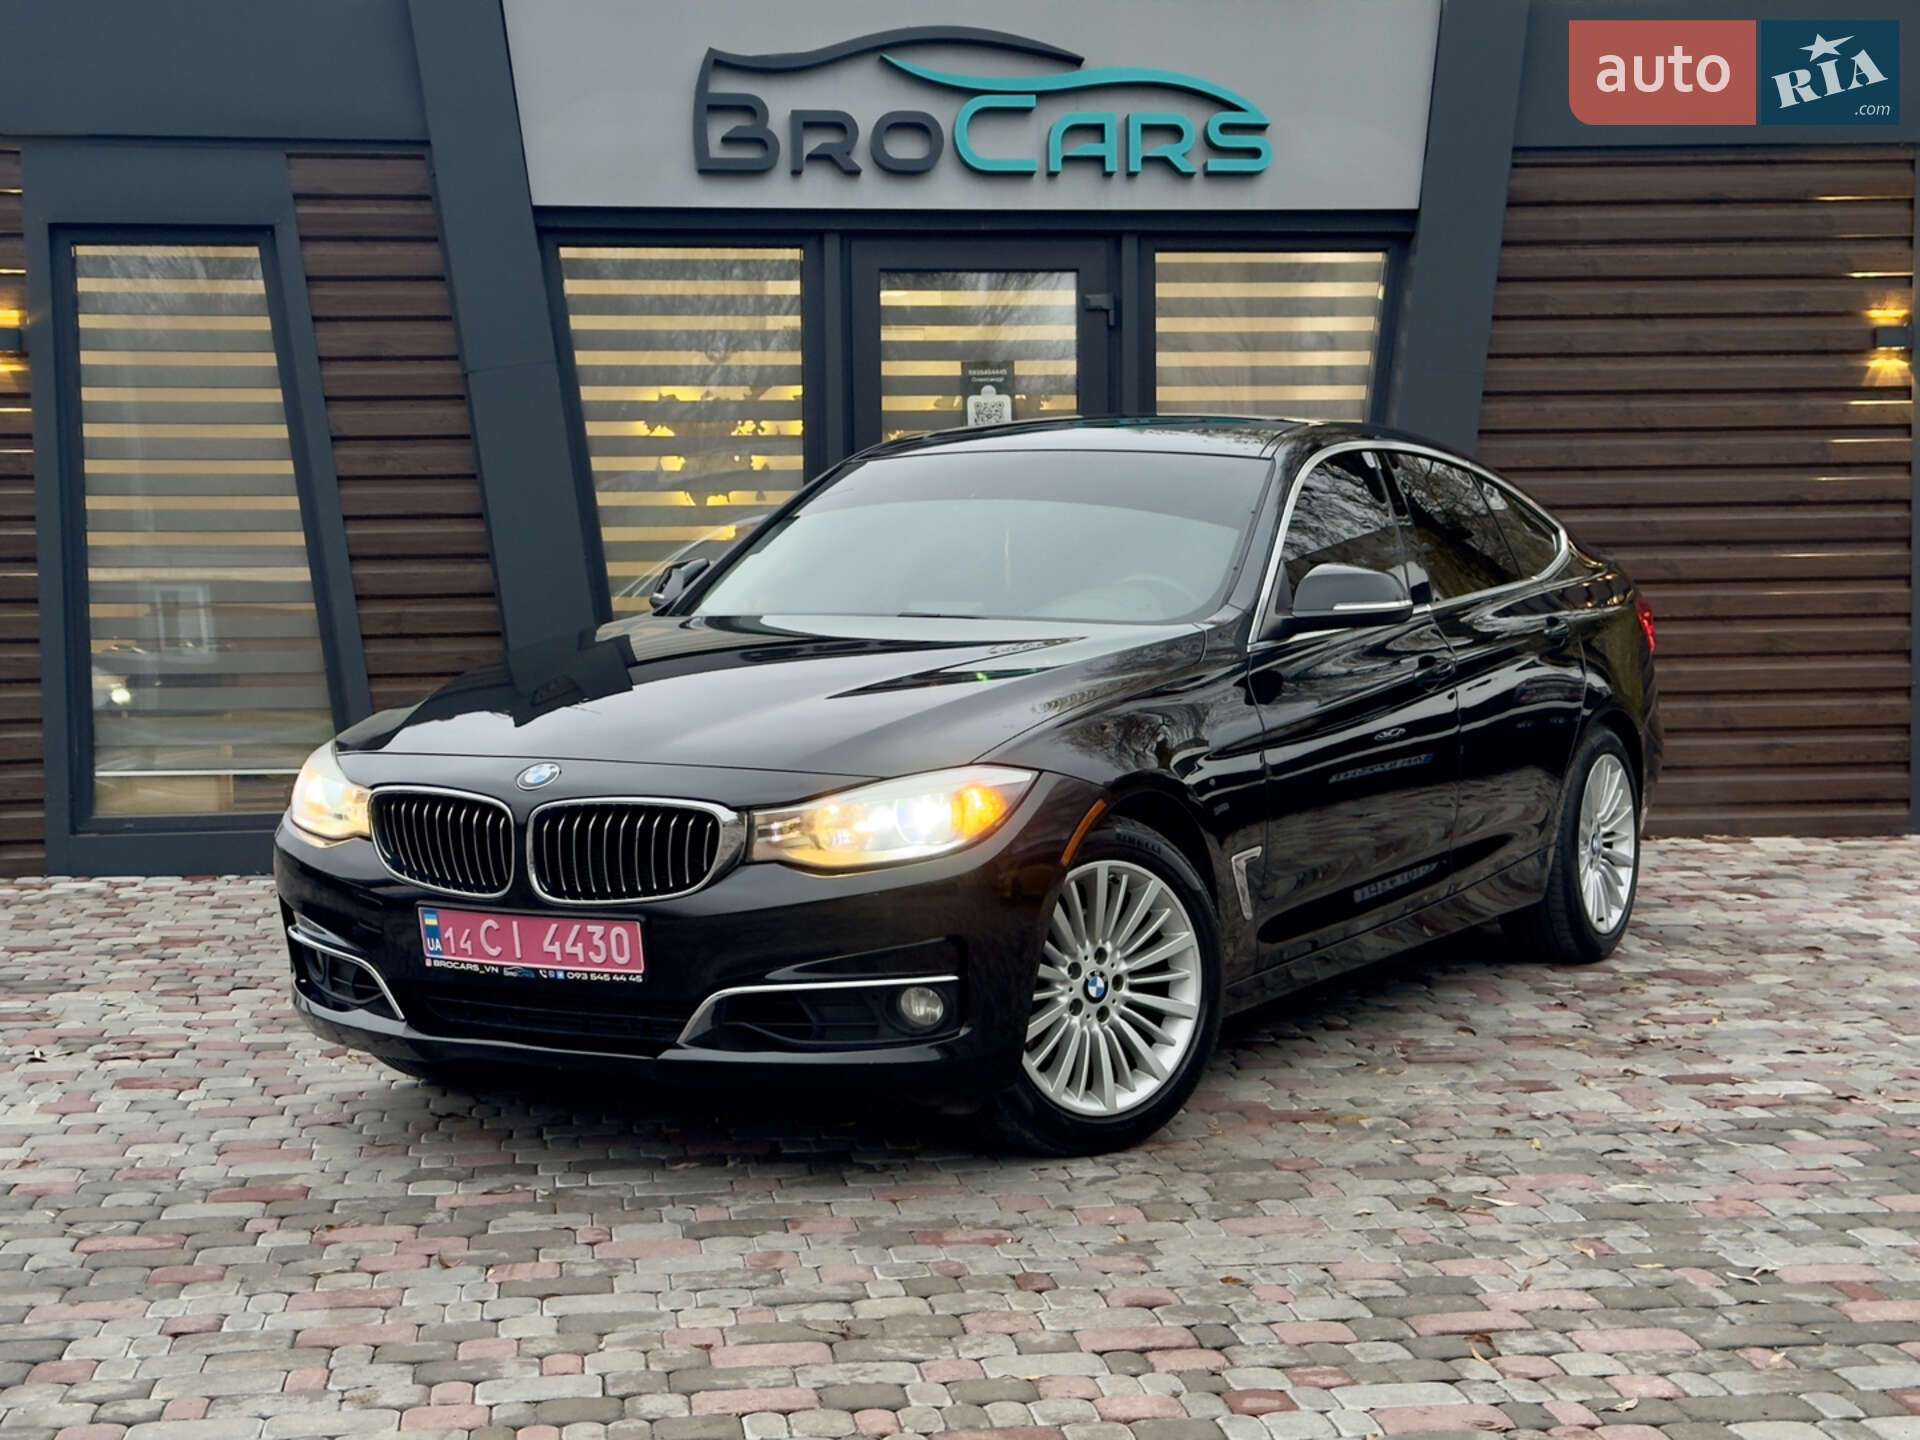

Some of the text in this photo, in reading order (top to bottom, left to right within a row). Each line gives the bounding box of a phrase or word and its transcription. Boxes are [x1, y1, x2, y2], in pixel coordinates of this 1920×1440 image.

[427, 937, 442, 951] UA
[444, 927, 472, 955] 14
[543, 923, 631, 965] 4430
